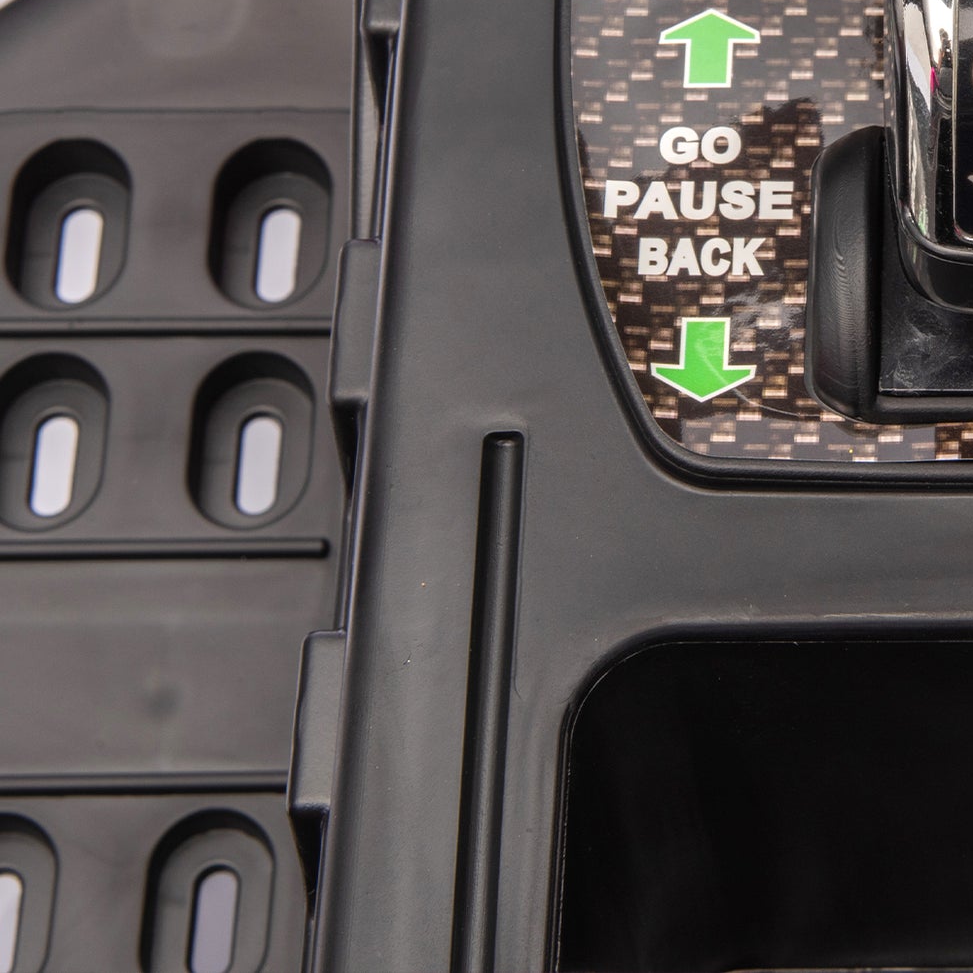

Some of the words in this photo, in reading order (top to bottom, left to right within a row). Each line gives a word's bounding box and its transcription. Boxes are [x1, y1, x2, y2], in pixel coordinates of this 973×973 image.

[660, 126, 742, 165] GO
[603, 180, 795, 221] PAUSE
[637, 237, 766, 277] BACK
